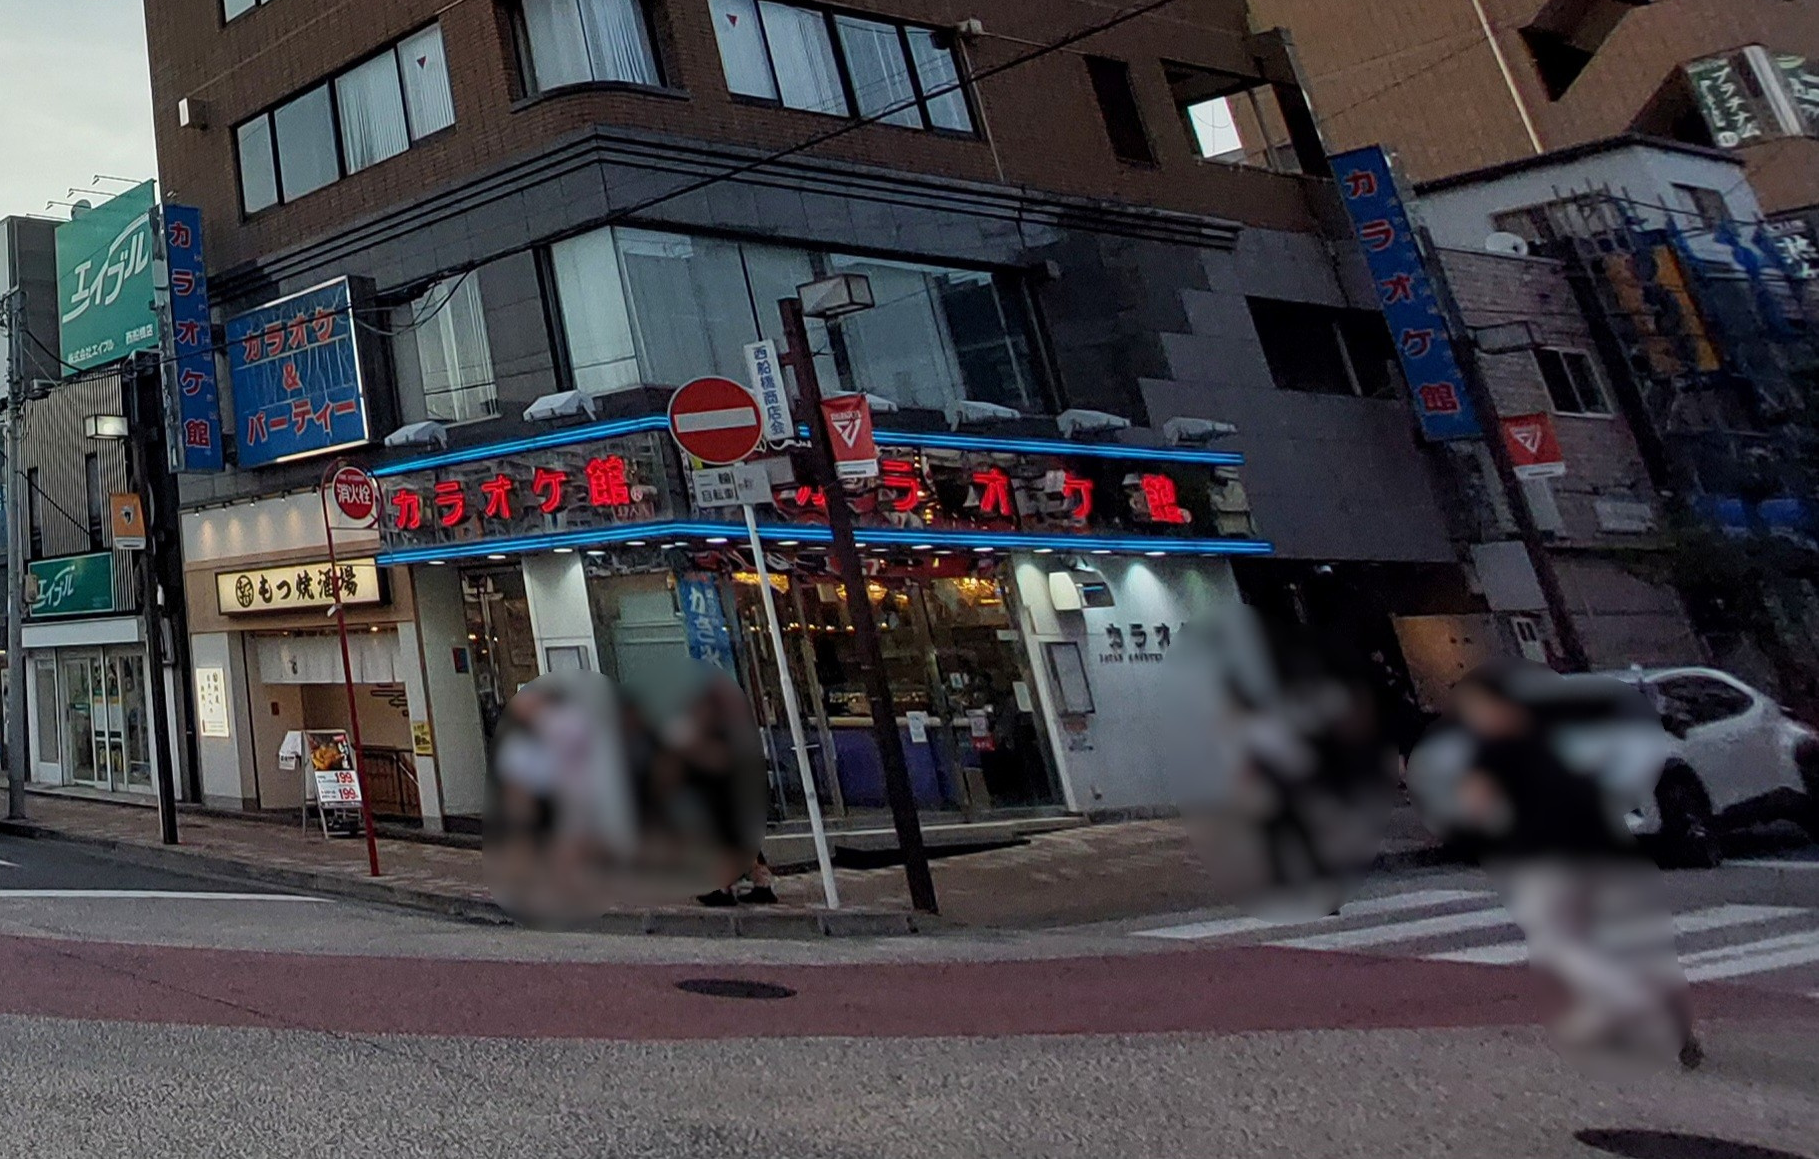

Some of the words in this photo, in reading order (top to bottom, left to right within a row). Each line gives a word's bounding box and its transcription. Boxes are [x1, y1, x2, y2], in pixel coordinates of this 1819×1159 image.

[66, 222, 150, 313] エイブル
[1345, 169, 1462, 415] カラオケ館
[168, 221, 211, 449] カラオケ館
[242, 307, 340, 362] カラオケ
[283, 362, 301, 390] &
[753, 345, 785, 437] 西船橋商店会
[247, 399, 357, 446] パーティー
[336, 483, 371, 505] 消火栓
[392, 454, 631, 529] カラオケ館
[34, 568, 75, 607] エイブル
[258, 564, 358, 604] もつ焼酒場
[335, 771, 352, 783] 199
[339, 787, 356, 799] 199
